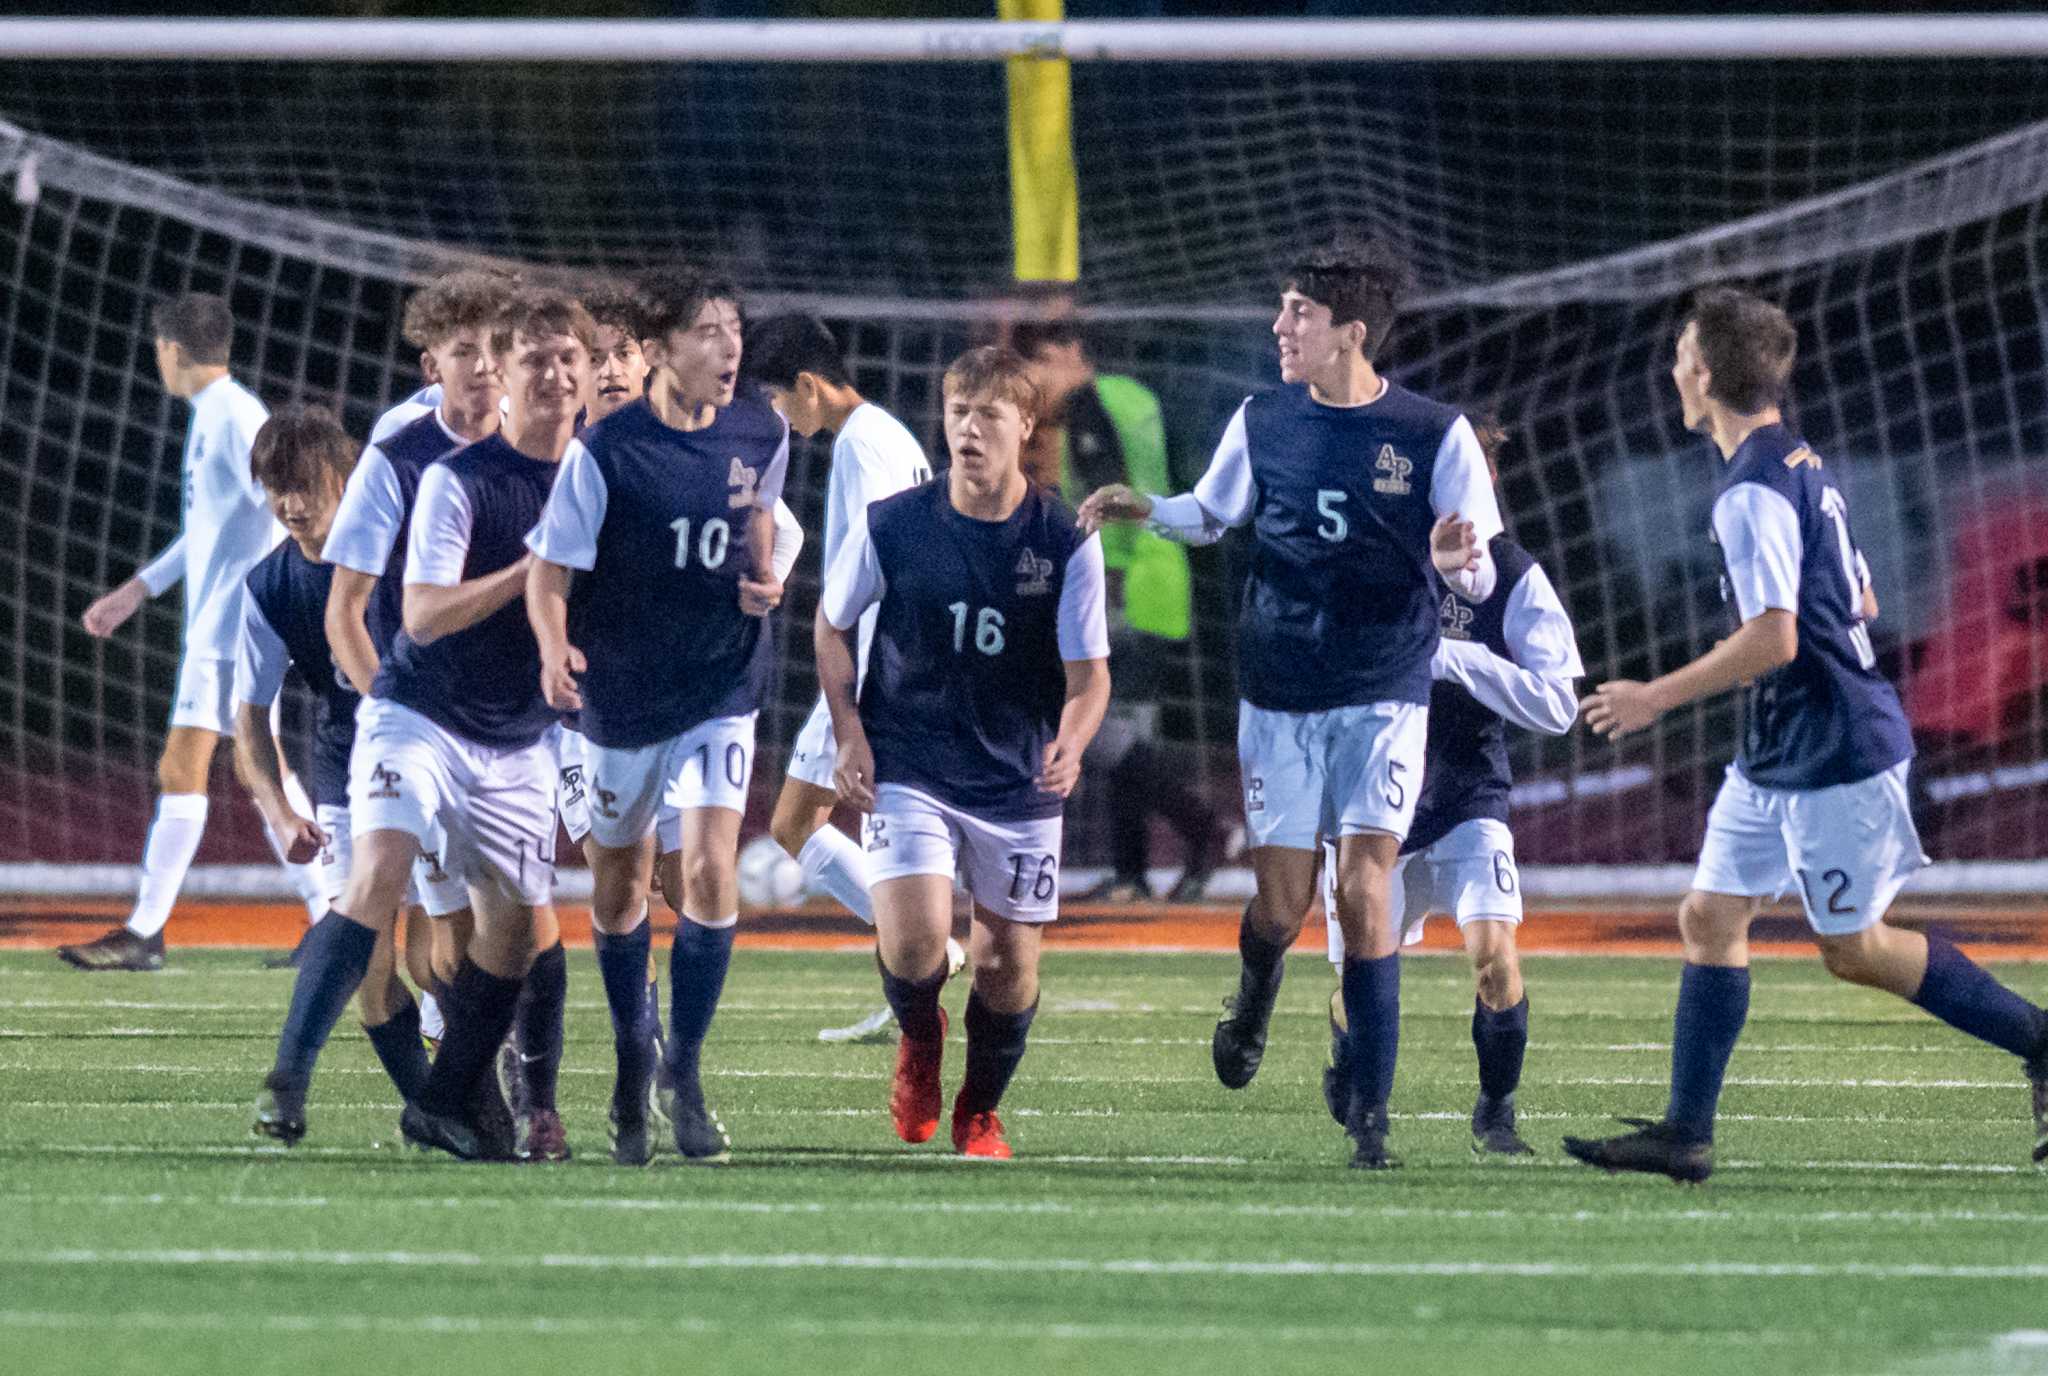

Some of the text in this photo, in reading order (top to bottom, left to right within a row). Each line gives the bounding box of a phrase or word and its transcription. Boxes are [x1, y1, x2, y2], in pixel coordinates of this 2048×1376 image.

[1375, 443, 1412, 480] AP
[1317, 489, 1348, 542] 5
[671, 517, 729, 569] 10
[1016, 547, 1053, 584] AP
[949, 601, 1005, 656] 16
[370, 761, 402, 787] AP
[696, 743, 745, 790] 10
[1386, 760, 1406, 811] 5
[1008, 853, 1056, 902] 16
[1493, 850, 1514, 896] 6
[1797, 868, 1857, 914] 12
